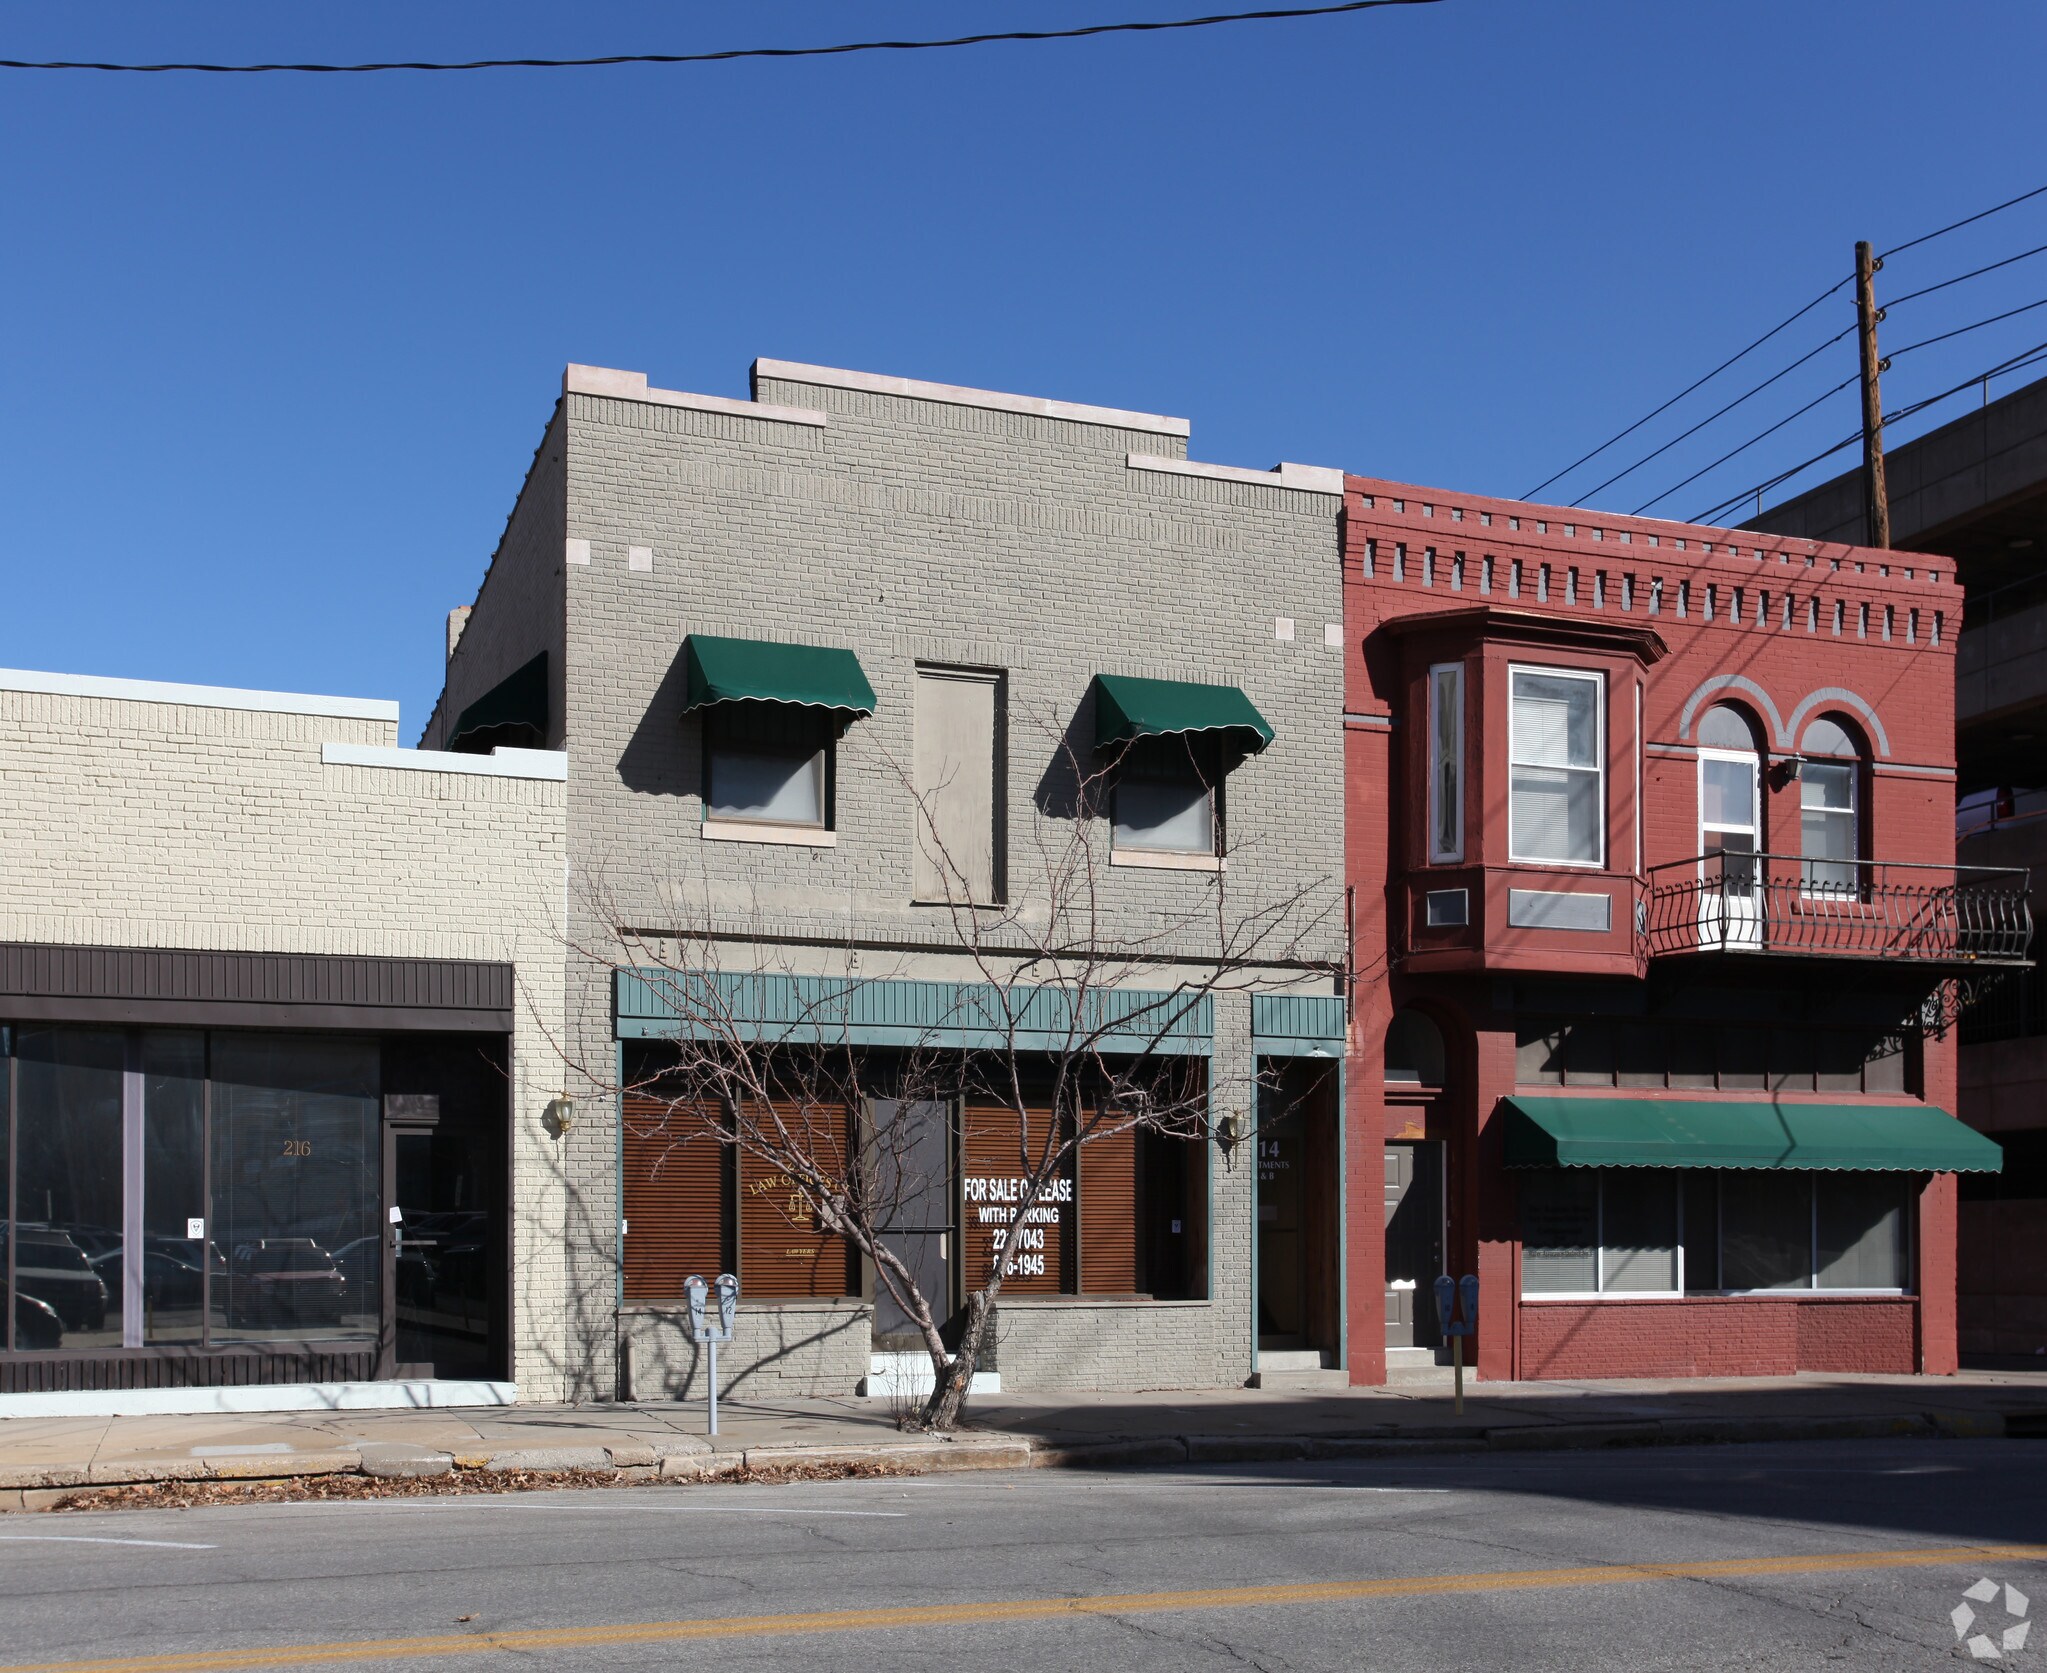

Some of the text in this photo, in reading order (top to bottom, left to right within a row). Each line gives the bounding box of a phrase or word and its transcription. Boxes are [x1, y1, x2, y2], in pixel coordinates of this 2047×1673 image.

[283, 1140, 311, 1156] 216
[1260, 1171, 1275, 1180] & B
[749, 1176, 777, 1196] LAW
[964, 1178, 987, 1201] FOR
[989, 1178, 1018, 1201] SALE
[978, 1207, 1060, 1223] WITH PRKING
[992, 1228, 1045, 1250] 227043
[992, 1254, 1045, 1276] 86-1945
